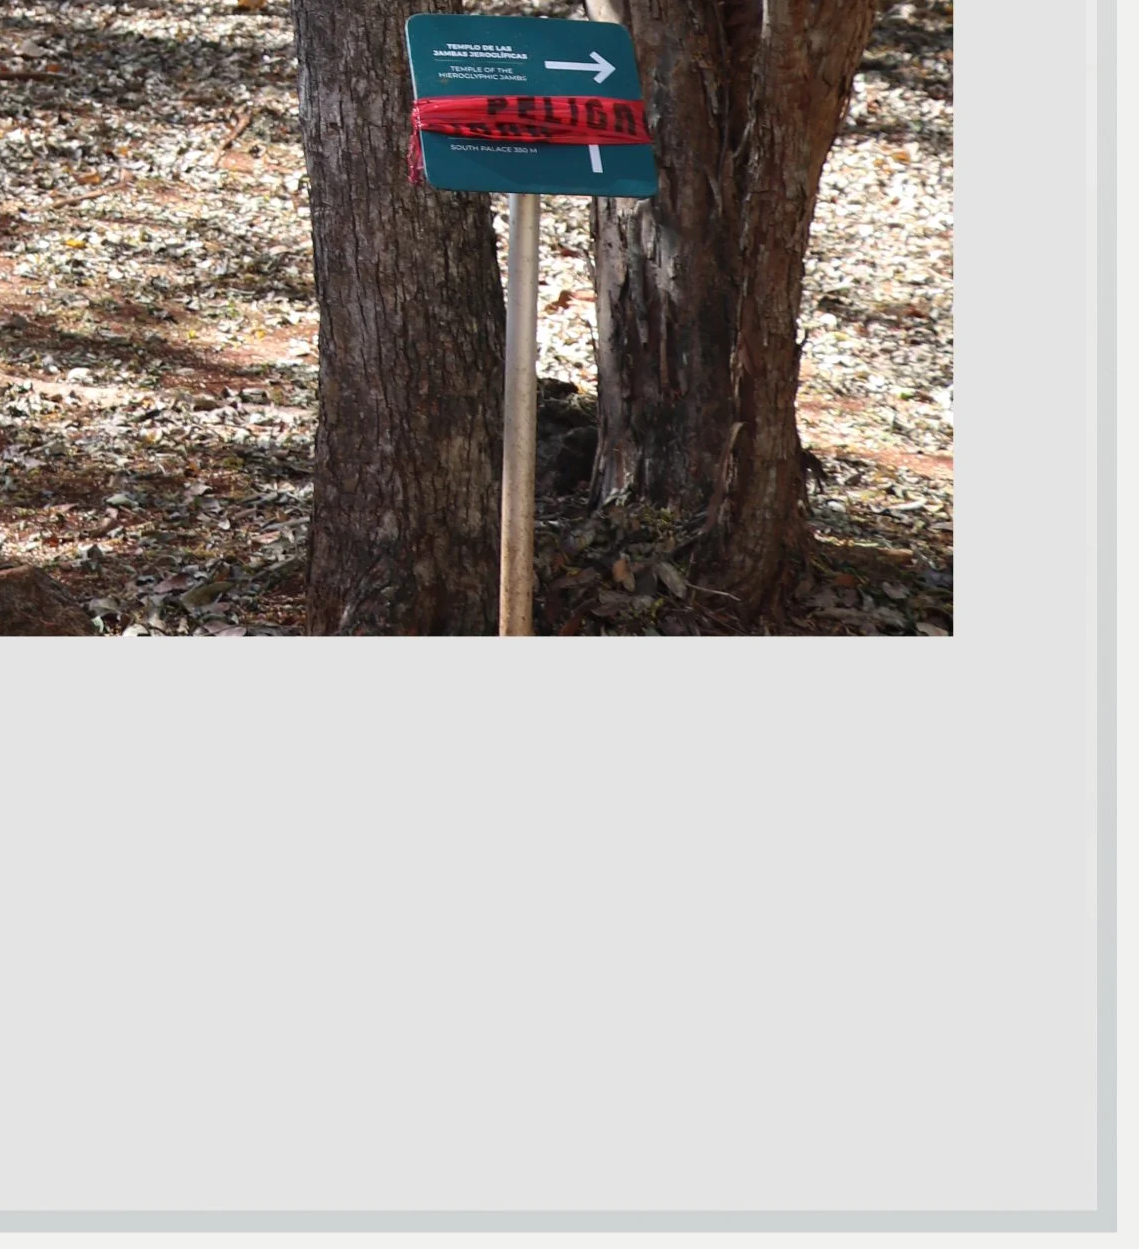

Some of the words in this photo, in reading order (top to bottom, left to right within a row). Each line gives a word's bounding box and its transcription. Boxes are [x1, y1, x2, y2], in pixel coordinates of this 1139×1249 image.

[446, 43, 481, 51] TEMPLO
[482, 44, 494, 52] DE
[433, 50, 468, 58] JAMBAS
[450, 65, 482, 73] TEMPLE
[497, 67, 513, 75] THE
[438, 72, 498, 81] HIEROGLYPHIC
[450, 144, 479, 152] SOUTH
[480, 145, 512, 153] PALACE
